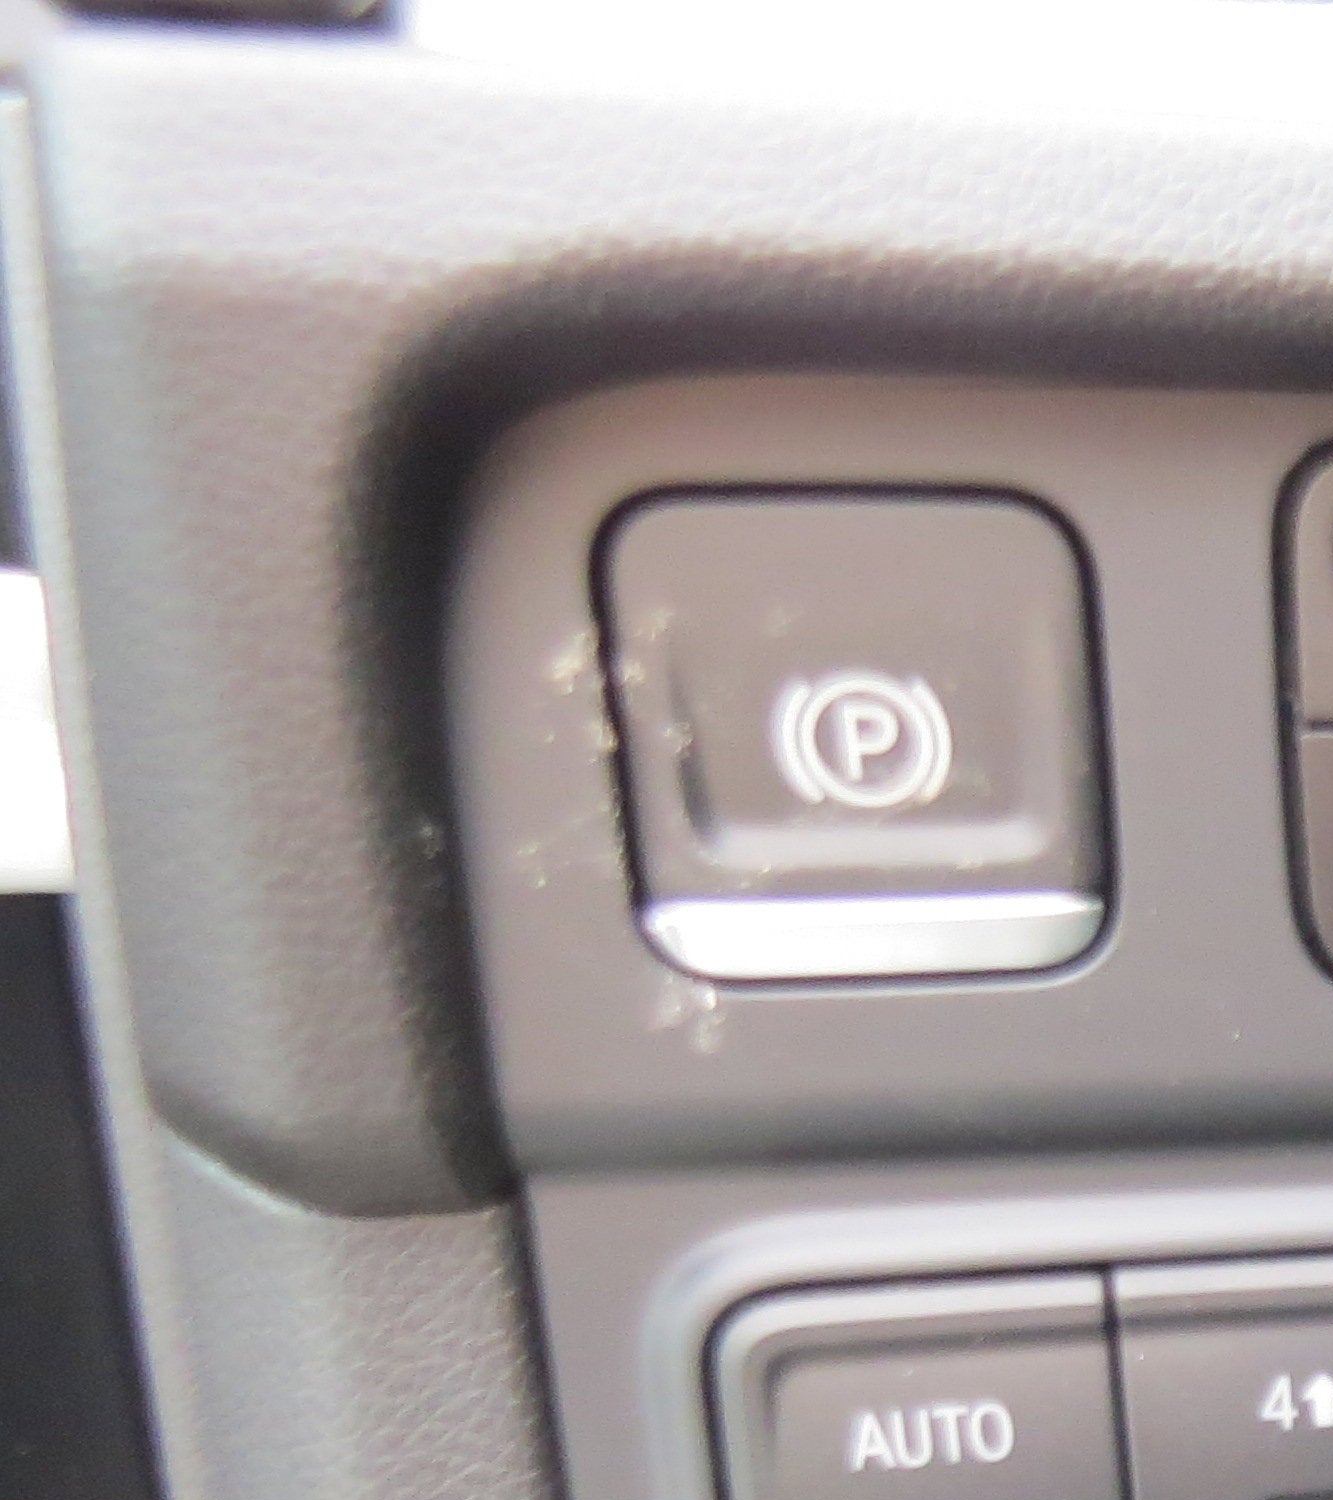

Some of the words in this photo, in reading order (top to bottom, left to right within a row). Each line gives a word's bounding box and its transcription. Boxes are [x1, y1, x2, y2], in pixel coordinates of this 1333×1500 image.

[838, 702, 899, 782] P
[851, 1402, 1014, 1471] AUTO
[1258, 1374, 1297, 1432] 4
